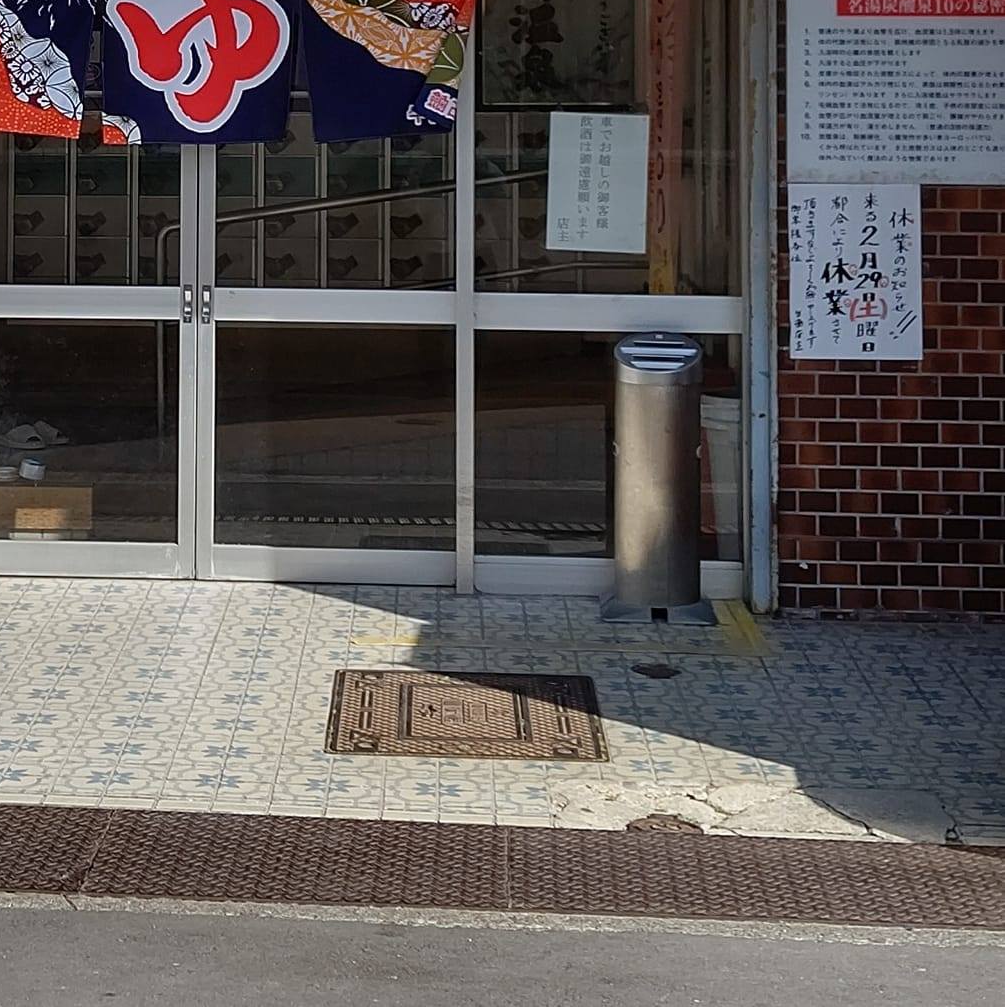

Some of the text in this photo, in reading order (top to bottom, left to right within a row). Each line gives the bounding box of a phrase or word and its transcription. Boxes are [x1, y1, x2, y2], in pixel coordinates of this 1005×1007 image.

[577, 115, 594, 240] 飲酒は御遠慮願います
[596, 116, 613, 229] 車でお越しの御客様
[556, 217, 571, 243] 店主
